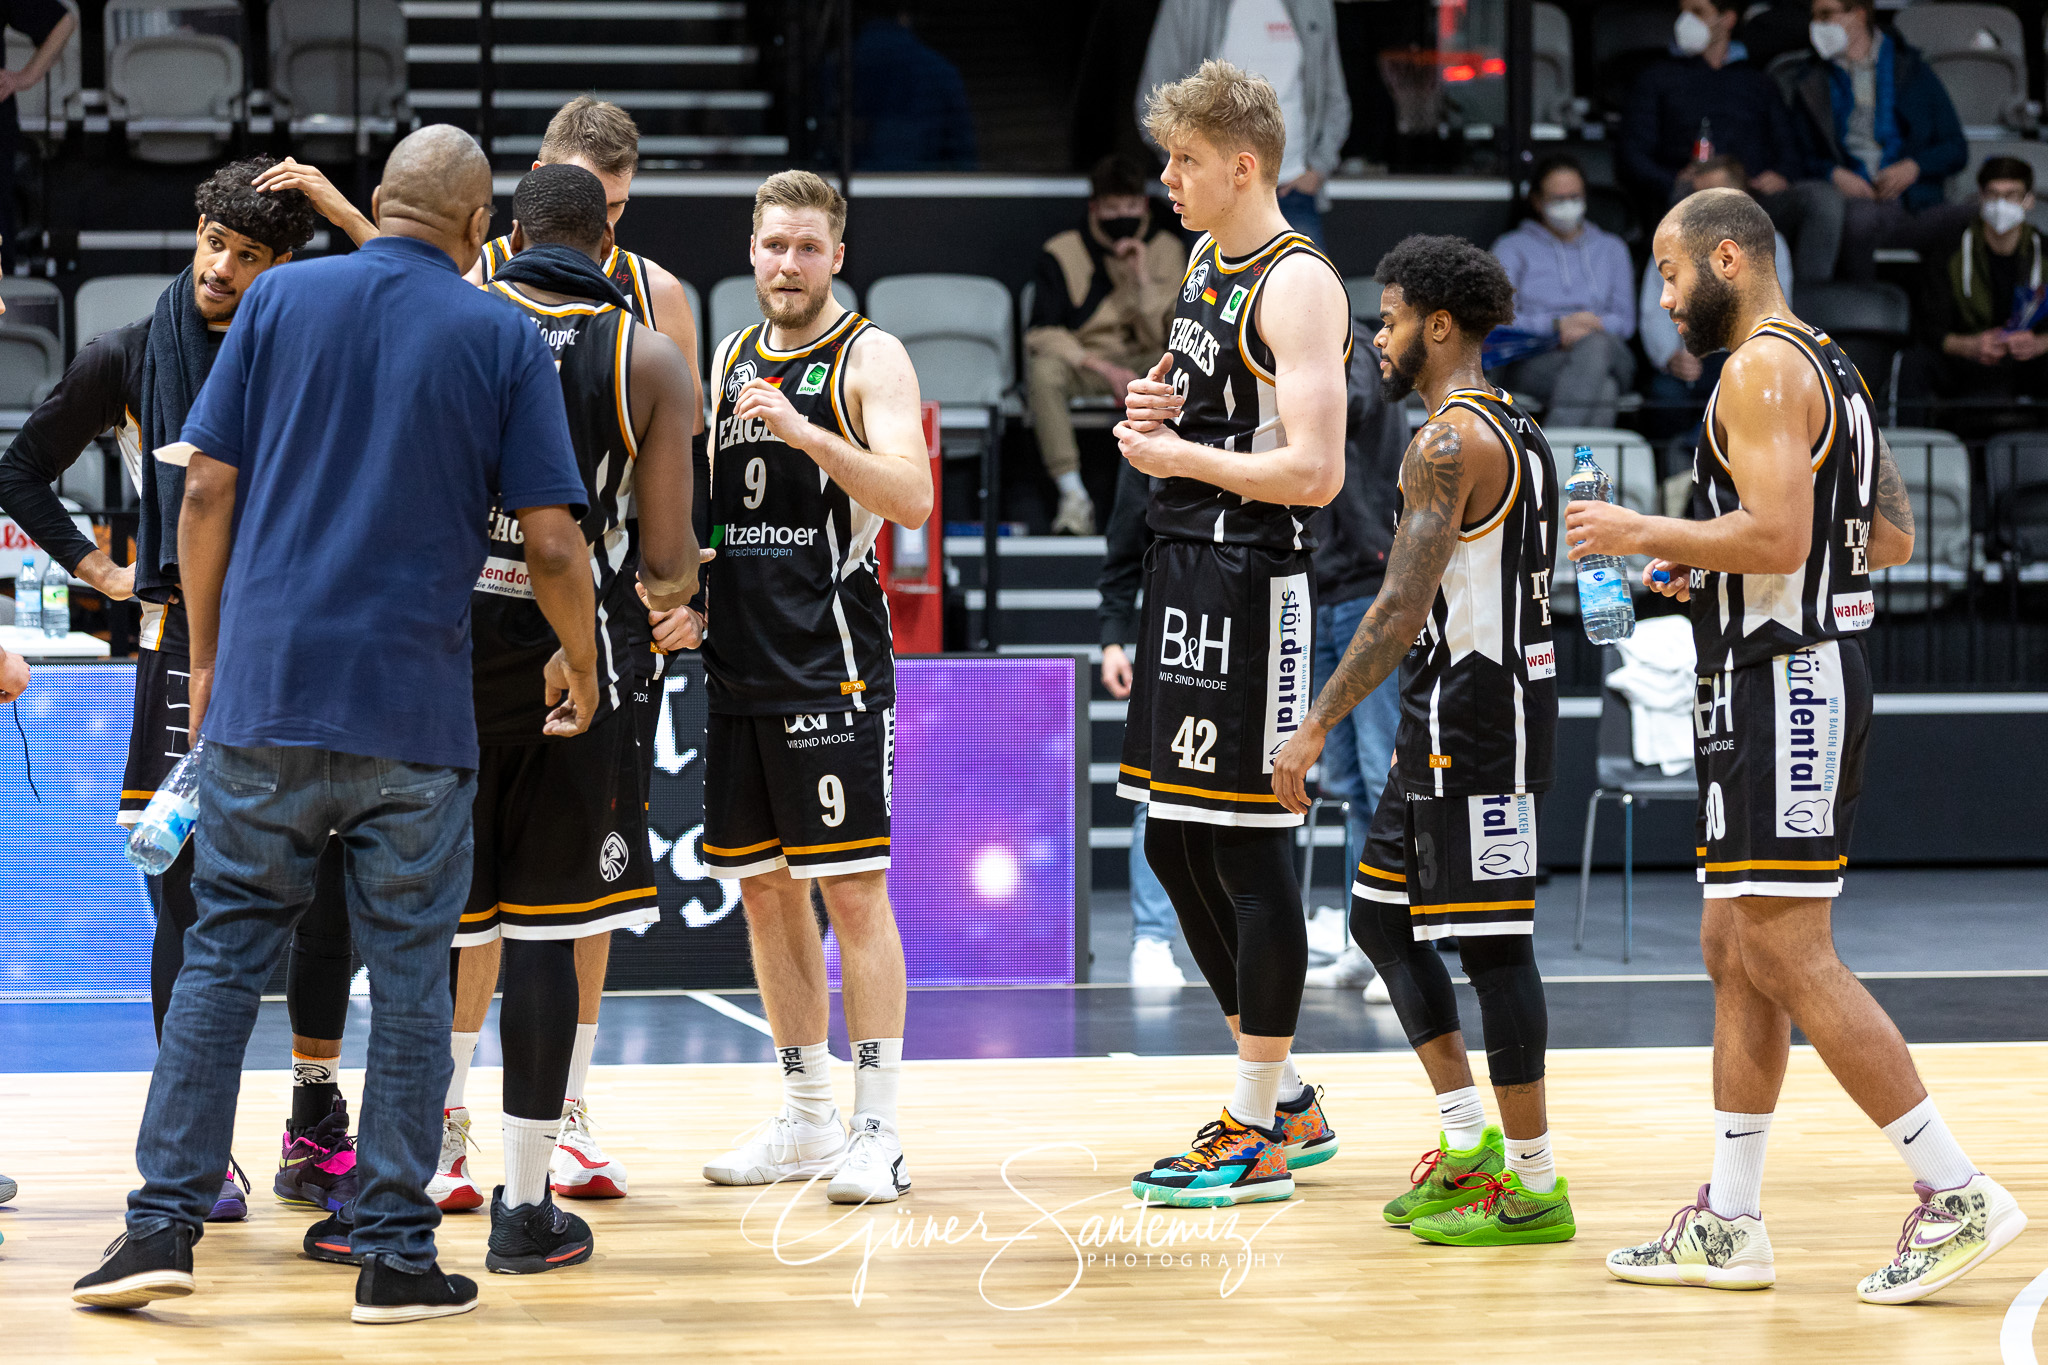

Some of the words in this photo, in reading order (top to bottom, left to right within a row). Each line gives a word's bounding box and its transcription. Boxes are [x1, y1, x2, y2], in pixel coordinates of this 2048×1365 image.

[530, 316, 579, 350] ooper
[1168, 317, 1220, 377] EAGLES
[743, 457, 767, 510] 9
[725, 522, 818, 546] Itzehoer
[1160, 606, 1232, 674] B&H
[1174, 674, 1195, 686] SIND
[1196, 677, 1227, 691] MODE
[1787, 648, 1828, 791] tördental
[1829, 697, 1839, 714] WIR
[798, 737, 820, 748] SIND
[821, 732, 856, 746] MODE
[1170, 715, 1218, 773] 42
[1828, 718, 1839, 747] BAUEN
[1824, 750, 1837, 792] BRÜCKEN
[817, 774, 846, 828] 9
[779, 1047, 806, 1076] PEAK
[857, 1041, 881, 1071] PEAK
